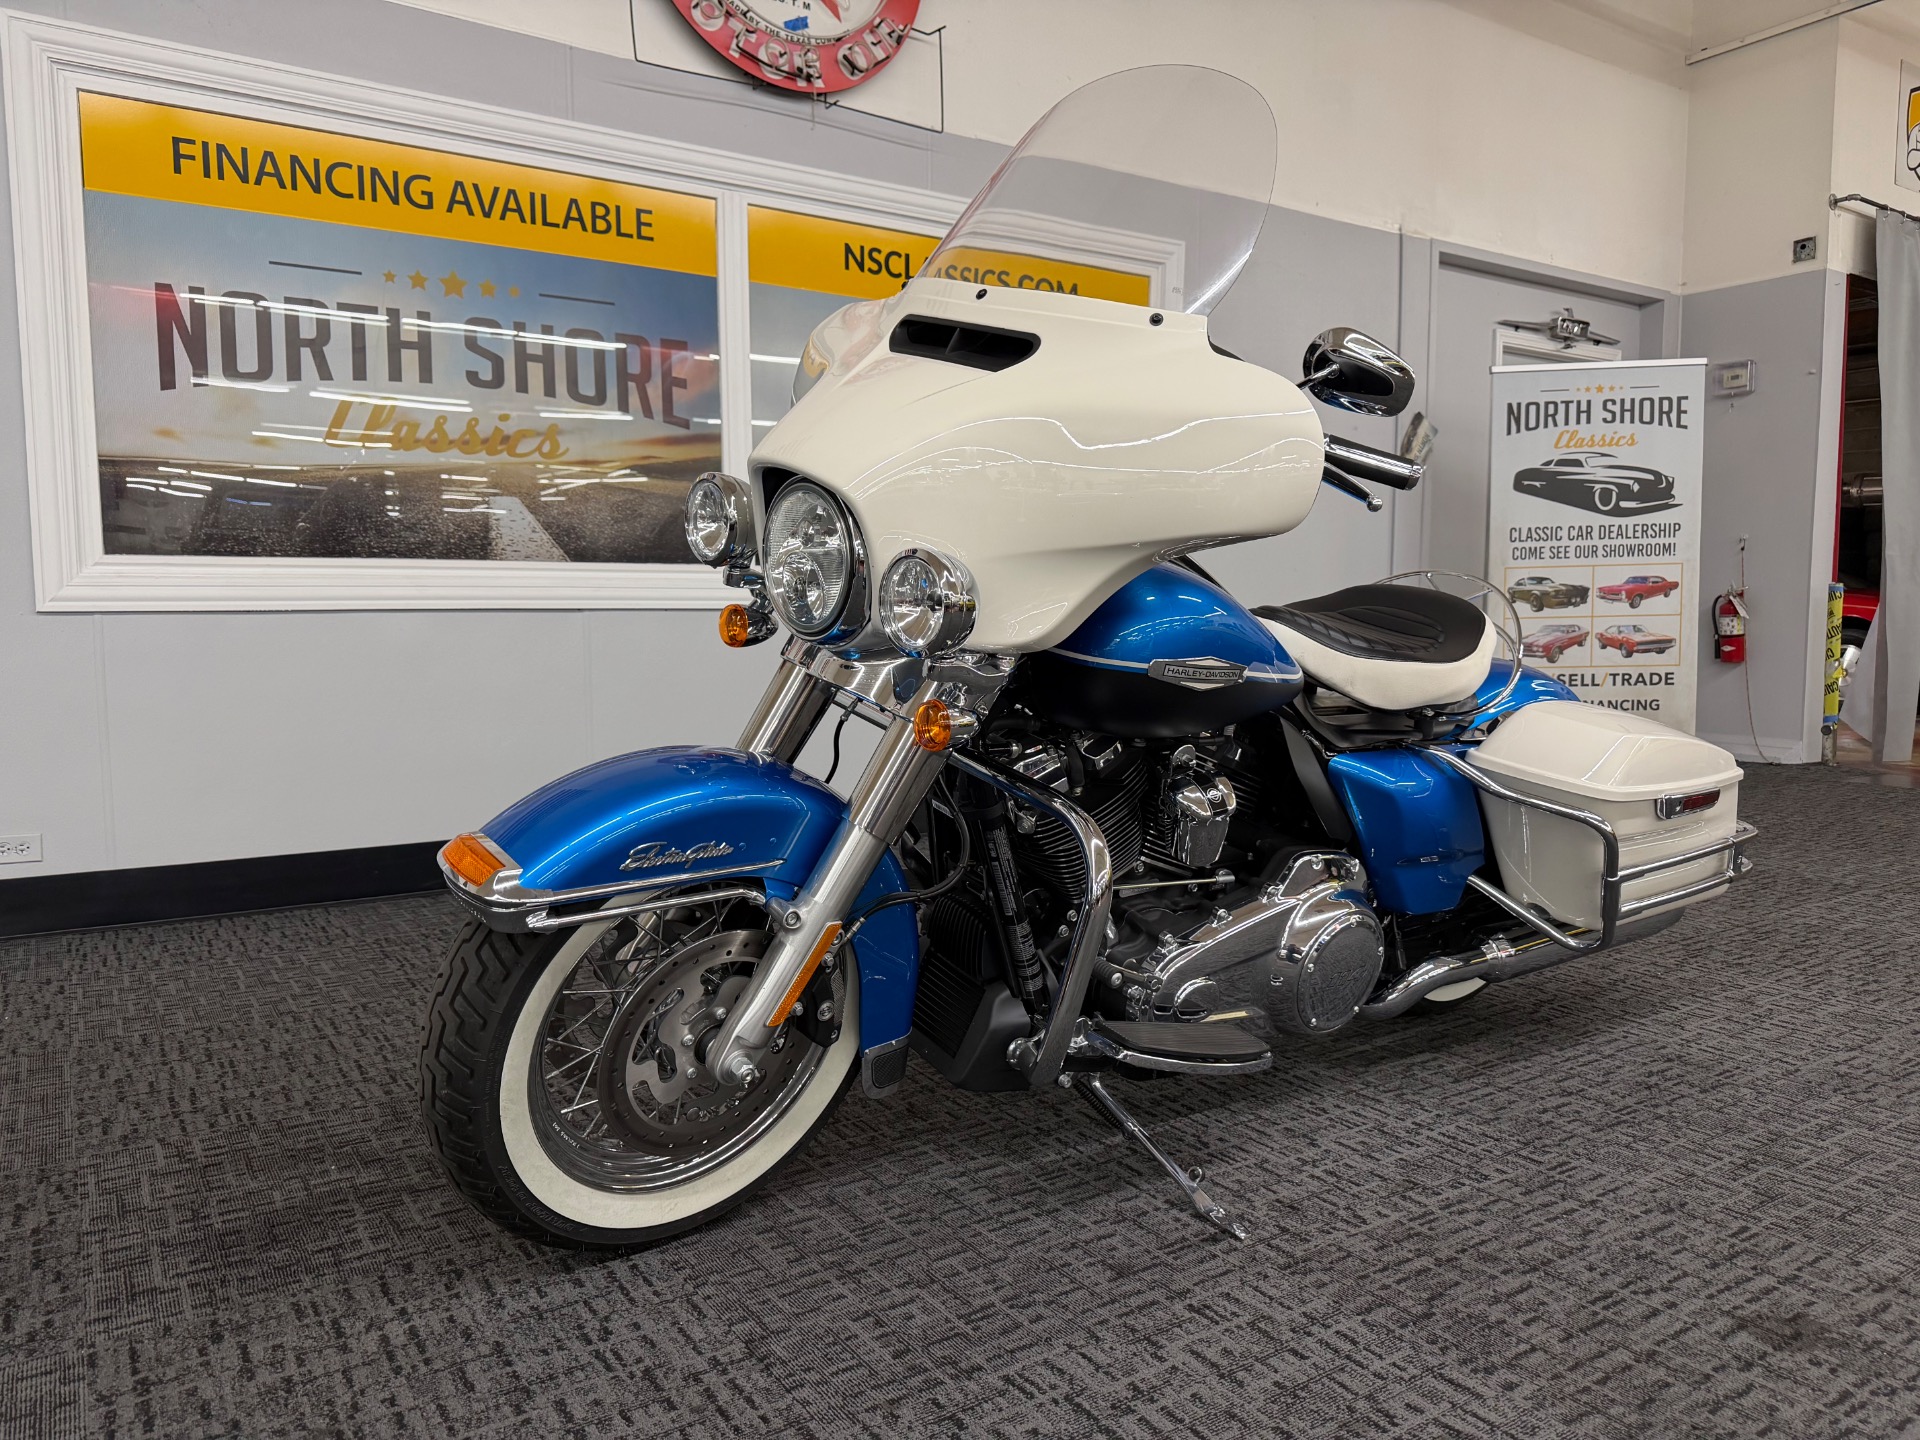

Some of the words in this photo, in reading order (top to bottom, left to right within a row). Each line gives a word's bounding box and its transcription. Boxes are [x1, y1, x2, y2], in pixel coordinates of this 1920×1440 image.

[764, 26, 781, 38] THE
[785, 34, 811, 45] TEXAS
[171, 136, 435, 211] FINANCING
[445, 180, 655, 242] AVAILABLE
[844, 242, 1079, 296] NSCLASSICSCOM
[154, 281, 434, 391] NORTH
[463, 316, 691, 430] SHORE
[323, 393, 570, 460] Classics
[1506, 399, 1592, 436] NORTH
[1601, 395, 1689, 430] SHORE
[1553, 429, 1639, 449] Classics
[1509, 525, 1563, 543] CLASSIC
[1567, 524, 1594, 541] CAR
[1598, 522, 1682, 540] DEALERSHIP
[1511, 546, 1546, 561] COME
[1549, 545, 1571, 560] SEE
[1574, 544, 1599, 560] OUR
[1601, 542, 1677, 559] SHOWROOM!
[1166, 667, 1240, 679] HARLEY-DAVIDSON
